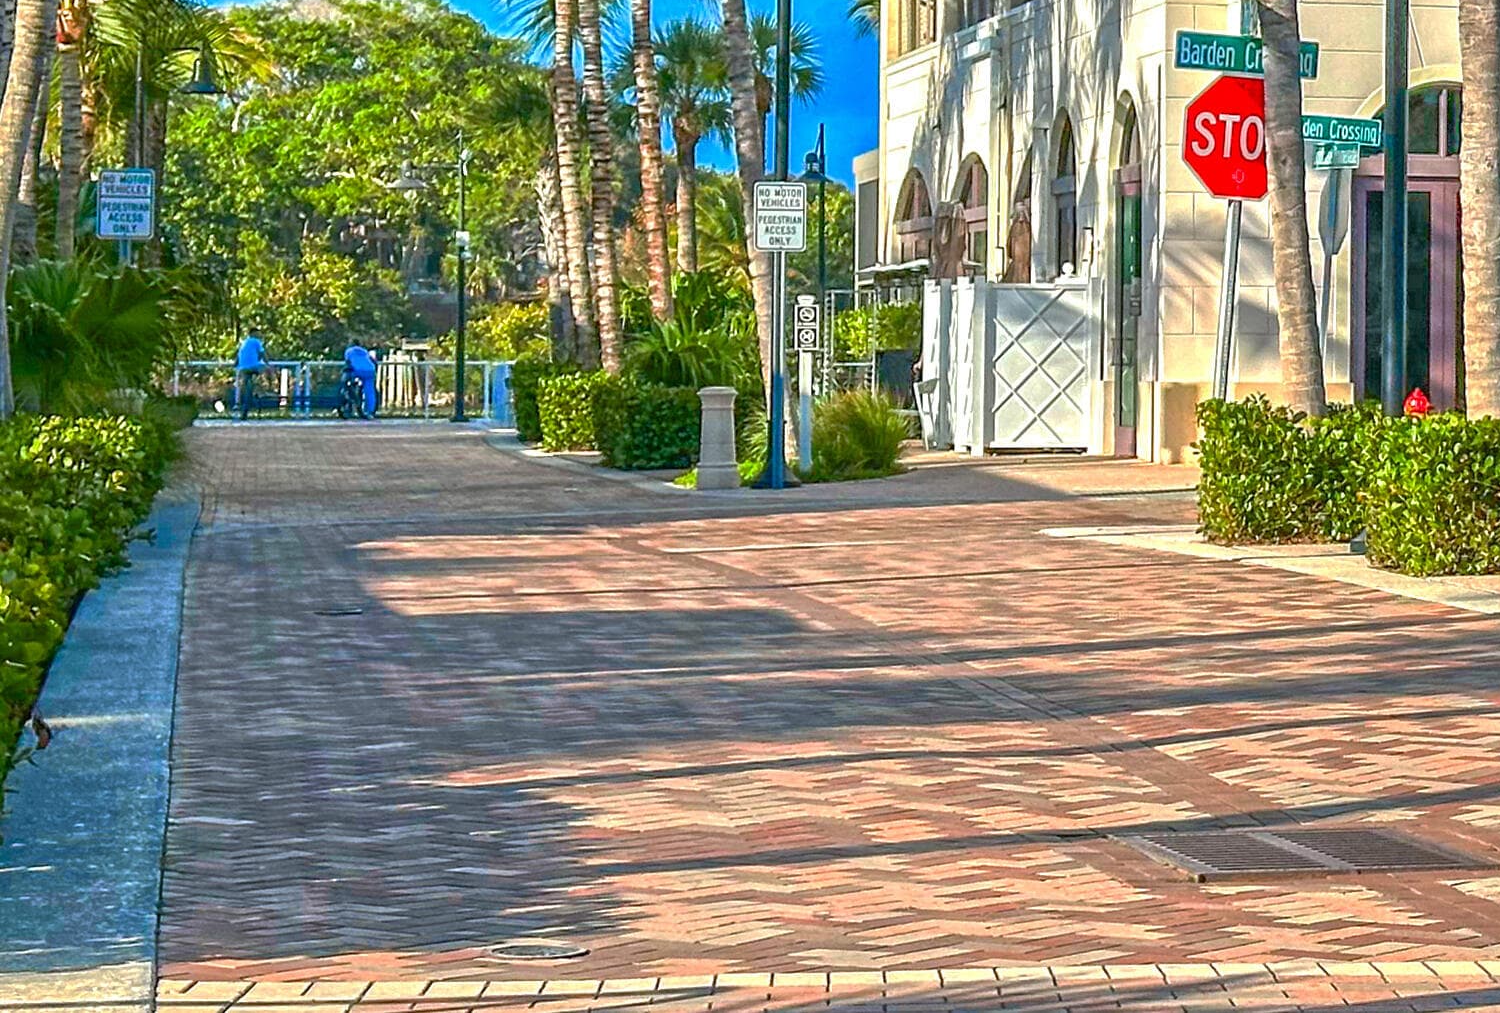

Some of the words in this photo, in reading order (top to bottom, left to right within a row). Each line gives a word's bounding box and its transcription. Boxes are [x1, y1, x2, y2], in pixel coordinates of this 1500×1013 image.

[1180, 36, 1236, 68] Barden
[1191, 111, 1264, 161] STO
[1302, 119, 1323, 138] den
[1329, 119, 1377, 143] Crossing
[758, 188, 771, 198] NO
[774, 188, 802, 198] MOTOR
[760, 198, 801, 207] VEHICLES
[108, 213, 144, 222] ACCESS
[758, 215, 802, 225] PEDESTRIAN
[113, 225, 137, 233] ONLY
[764, 225, 797, 236] ACCESS
[768, 236, 792, 246] ONLY
